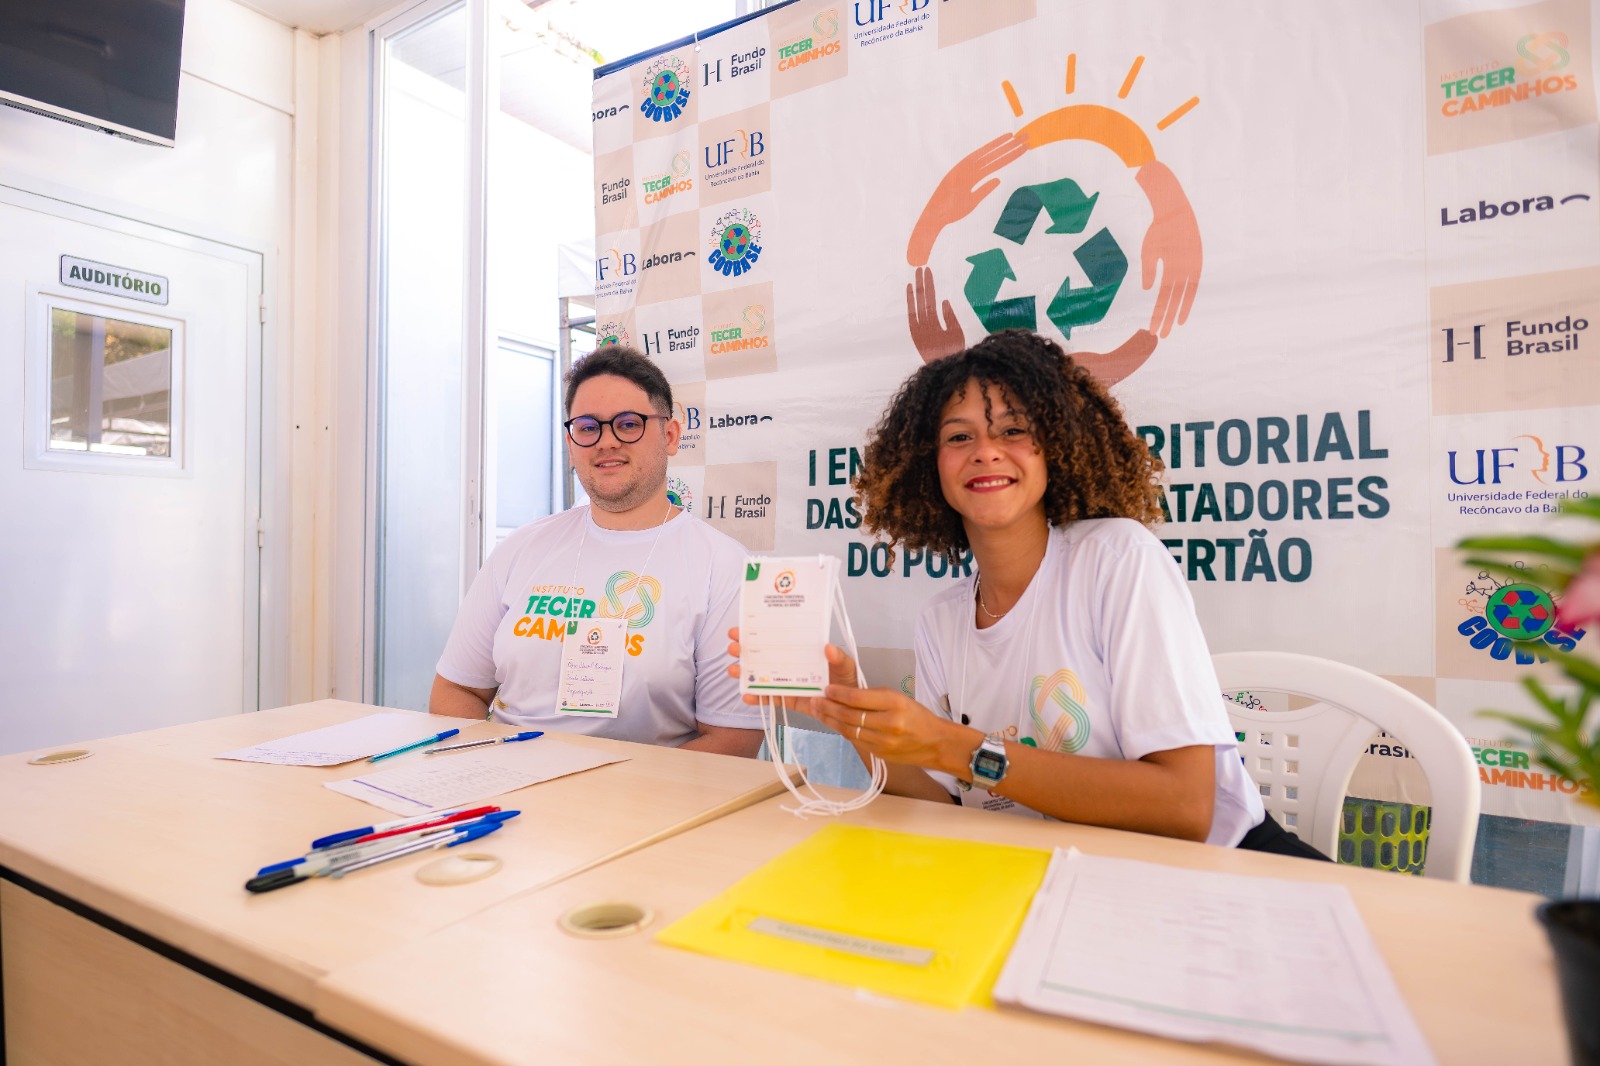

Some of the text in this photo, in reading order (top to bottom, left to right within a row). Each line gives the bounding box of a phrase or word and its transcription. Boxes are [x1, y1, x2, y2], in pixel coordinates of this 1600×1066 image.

[731, 46, 766, 66] Fundo
[778, 37, 813, 60] TECER
[778, 40, 841, 72] CAMINHOS
[731, 59, 762, 78] Brasil
[1441, 66, 1515, 99] TECER
[640, 87, 691, 123] COOBASE
[1441, 74, 1578, 118] CAMINHOS
[602, 176, 630, 194] Fundo
[642, 175, 671, 193] TECER
[644, 178, 693, 205] CAMINHOS
[602, 188, 628, 205] Brasil
[1441, 195, 1554, 226] Labora
[641, 251, 682, 271] Labora
[708, 242, 763, 277] COOBASE
[70, 265, 161, 296] AUDITÓRIO
[668, 325, 700, 340] Fundo
[711, 327, 742, 343] TECER
[1506, 315, 1589, 338] Fundo
[669, 337, 696, 352] Brasil
[711, 335, 769, 355] CAMINHOS
[1507, 333, 1579, 357] Brasil
[709, 413, 758, 429] Labora
[808, 449, 817, 487] I
[1136, 409, 1390, 469] RITORIAL
[735, 494, 772, 506] Fundo
[806, 475, 1391, 530] DAS ATADORES
[1448, 489, 1589, 502] Universidade Federal do
[734, 507, 766, 519] Brasil
[1460, 503, 1566, 515] Recôncavo da Bah
[847, 528, 1314, 583] DO POR ERTÃO
[525, 595, 596, 619] TECER
[1465, 737, 1513, 749] STITUTO
[1471, 747, 1530, 770] ECER
[1478, 766, 1596, 797] AMINHOS
